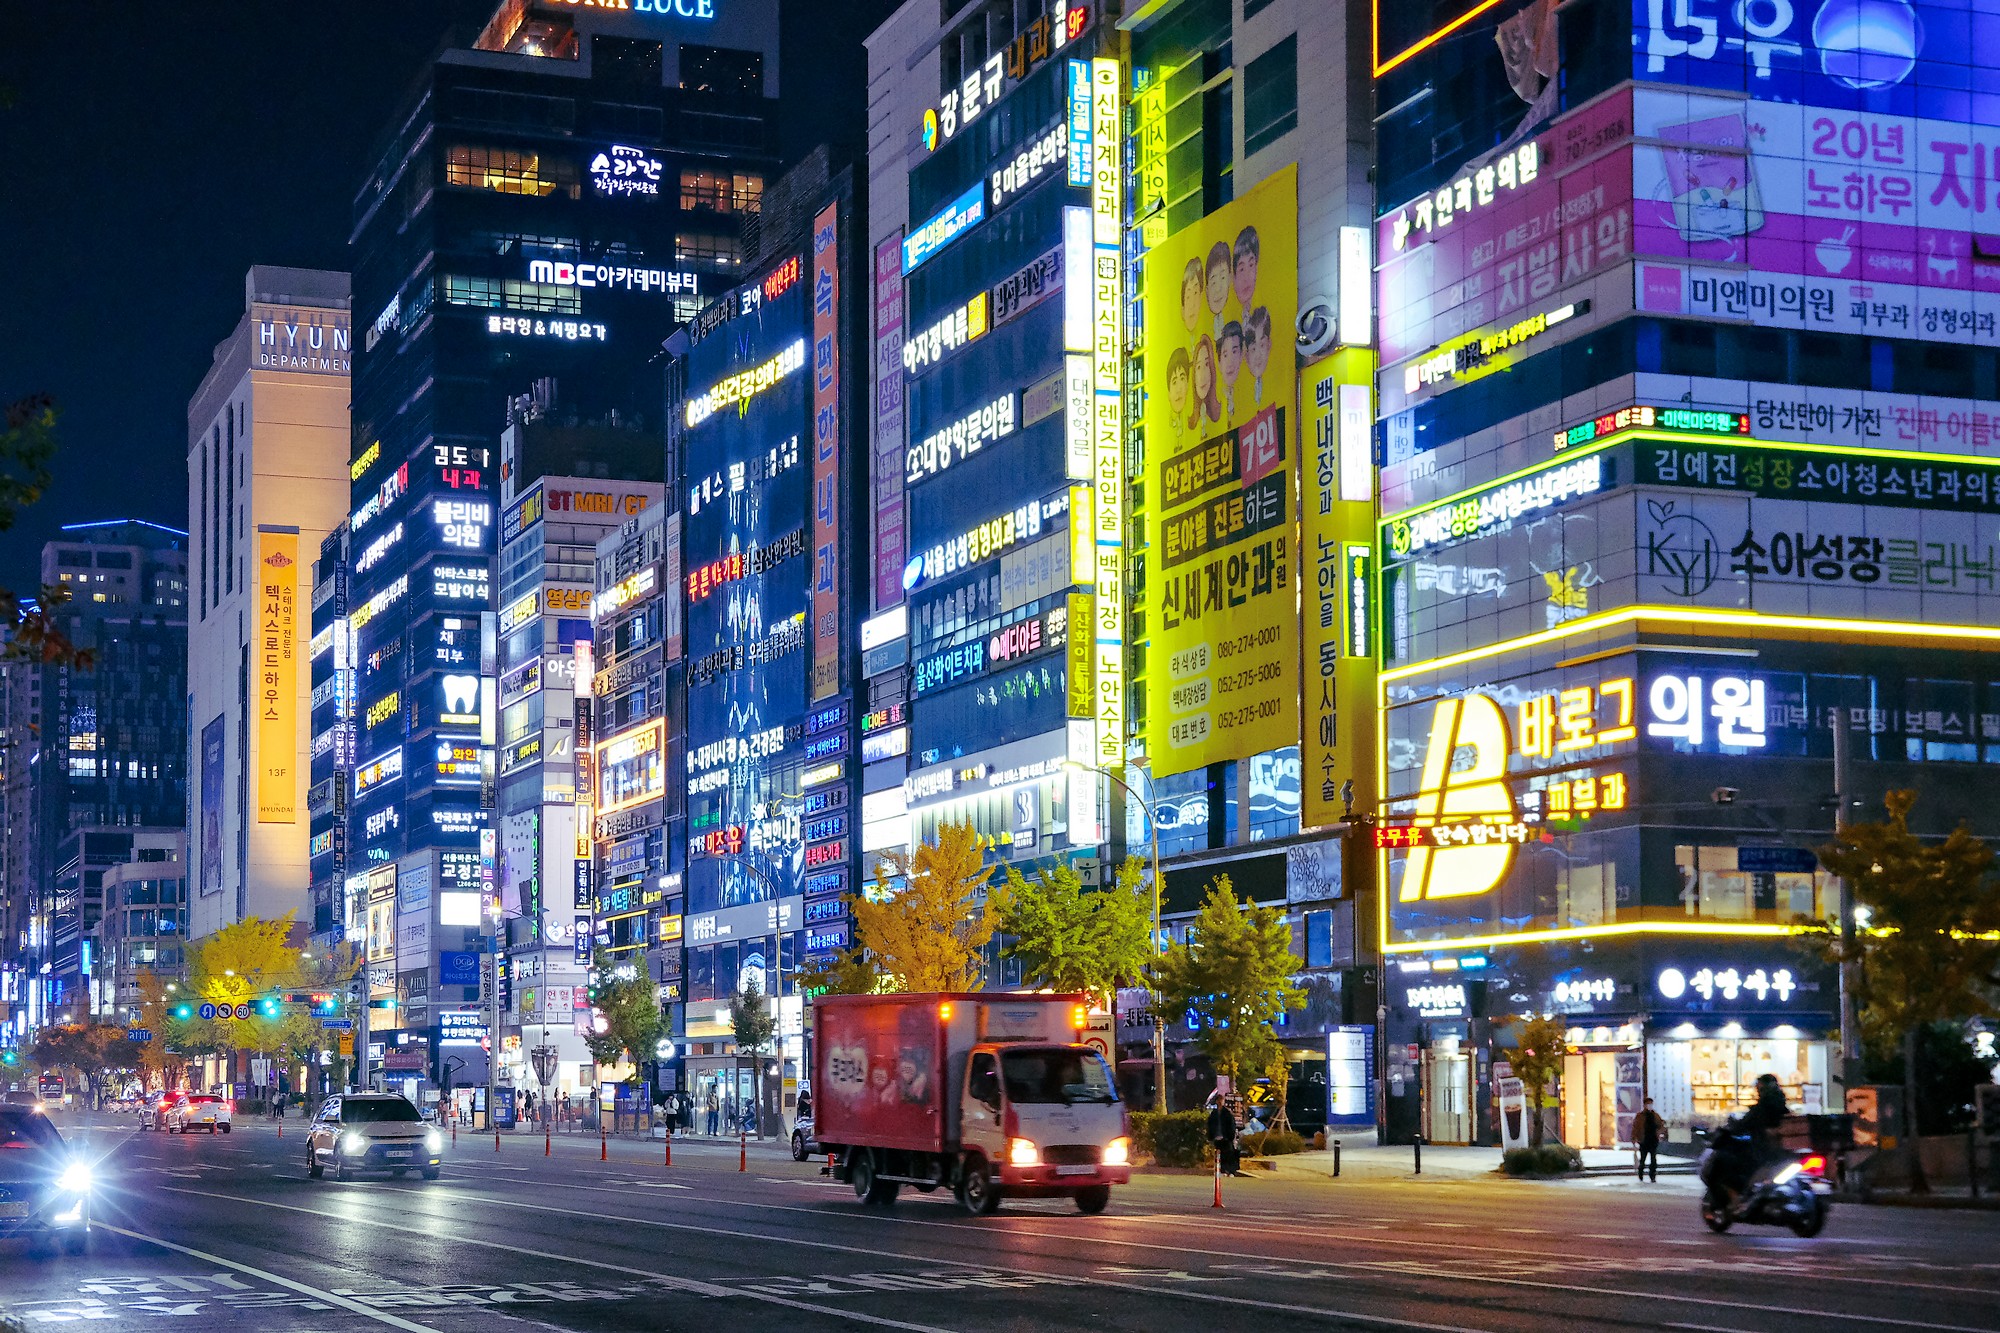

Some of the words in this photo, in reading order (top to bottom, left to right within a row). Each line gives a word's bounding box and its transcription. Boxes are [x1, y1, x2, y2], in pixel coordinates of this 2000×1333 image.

[1068, 5, 1085, 39] 9F
[1096, 92, 1118, 220] 신세계안과
[1811, 116, 1905, 165] 20년
[1415, 141, 1538, 233] 자연과한의원
[1807, 168, 1913, 217] 노하우
[741, 284, 762, 315] 코아
[1691, 277, 1835, 323] 미앤미의원
[1850, 300, 1910, 330] 피부과
[1920, 305, 1998, 338] 성형외과
[534, 322, 546, 335] &
[879, 333, 901, 371] 서울
[903, 305, 969, 374] 하지정맥류
[1098, 283, 1119, 386] 라식라섹
[879, 374, 901, 410] 삼성
[815, 268, 837, 596] 속편한내과
[1755, 398, 1835, 434] 당신만이
[1841, 406, 1882, 438] 가진
[1098, 402, 1120, 532] 렌즈삽입술
[1165, 439, 1234, 502] 안과전문의
[1242, 413, 1276, 473] 7인
[1315, 374, 1336, 516] 백내장과
[442, 468, 481, 489] 내과
[574, 492, 614, 513] MRI
[443, 525, 480, 547] 의원
[923, 500, 1041, 580] 서울삼성정형외과의원
[1166, 509, 1208, 560] 분야별
[282, 586, 292, 625] 스테이크
[434, 582, 489, 600] 모발이식
[1099, 553, 1120, 631] 백내장
[1161, 539, 1276, 632] 신세계안과
[1275, 536, 1287, 590] 의원
[1317, 533, 1336, 629] 노안을
[282, 629, 292, 659] 전문점
[818, 611, 836, 639] 의원
[999, 619, 1041, 662] 메디아트
[1171, 646, 1206, 674] 라식상담
[1217, 624, 1281, 660] 080-274-0001
[264, 584, 280, 721] 텍사스로드하우스
[917, 641, 984, 692] 울산화이트치과
[1099, 654, 1121, 757] 노안수술
[1171, 683, 1207, 709] 백내장상담
[1217, 660, 1281, 694] 052-275-5006
[1319, 640, 1337, 748] 동시에
[1171, 717, 1207, 743] 대표번호
[1217, 697, 1281, 730] 052-275-0001
[1518, 676, 1637, 760] 바로그
[1648, 673, 1767, 748] 의원
[268, 768, 286, 777] 13F
[579, 757, 589, 792] 피부과
[1321, 752, 1335, 802] 수술
[1547, 772, 1628, 822] 피부과
[260, 806, 293, 814] HYUNDAI
[432, 811, 473, 825] 한국투자
[692, 915, 716, 939] 삼성증권
[236, 1007, 249, 1018] 60
